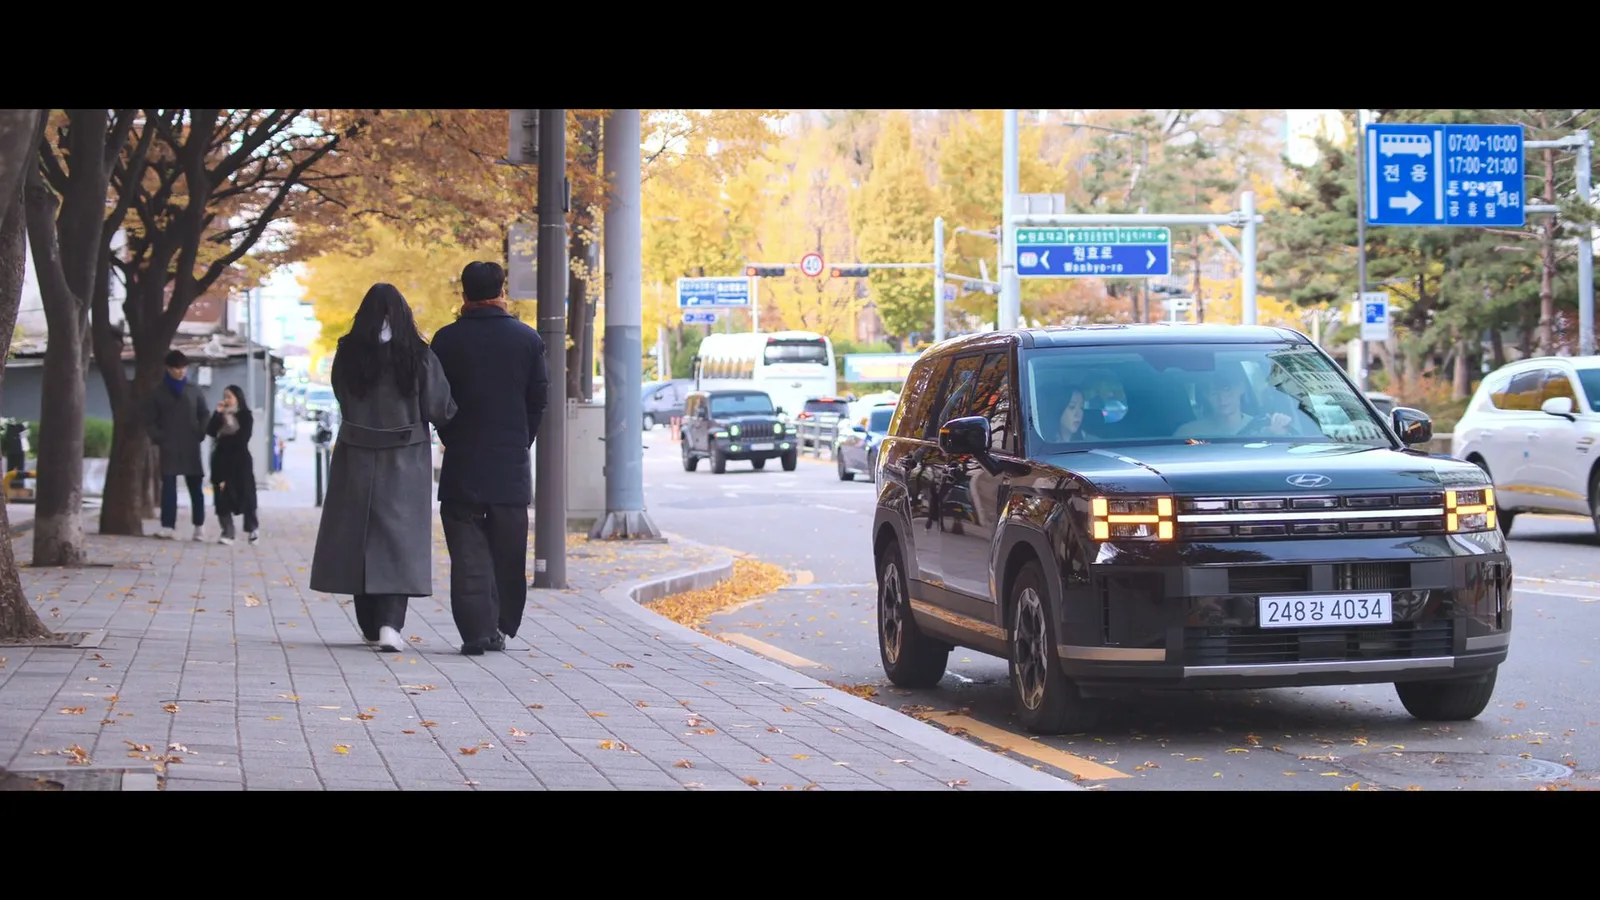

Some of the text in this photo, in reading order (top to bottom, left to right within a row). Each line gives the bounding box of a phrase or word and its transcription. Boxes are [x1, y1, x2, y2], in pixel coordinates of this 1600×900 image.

[1072, 246, 1113, 262] 원효로
[805, 259, 819, 271] 40
[1063, 262, 1124, 274] Wonhyo-ro
